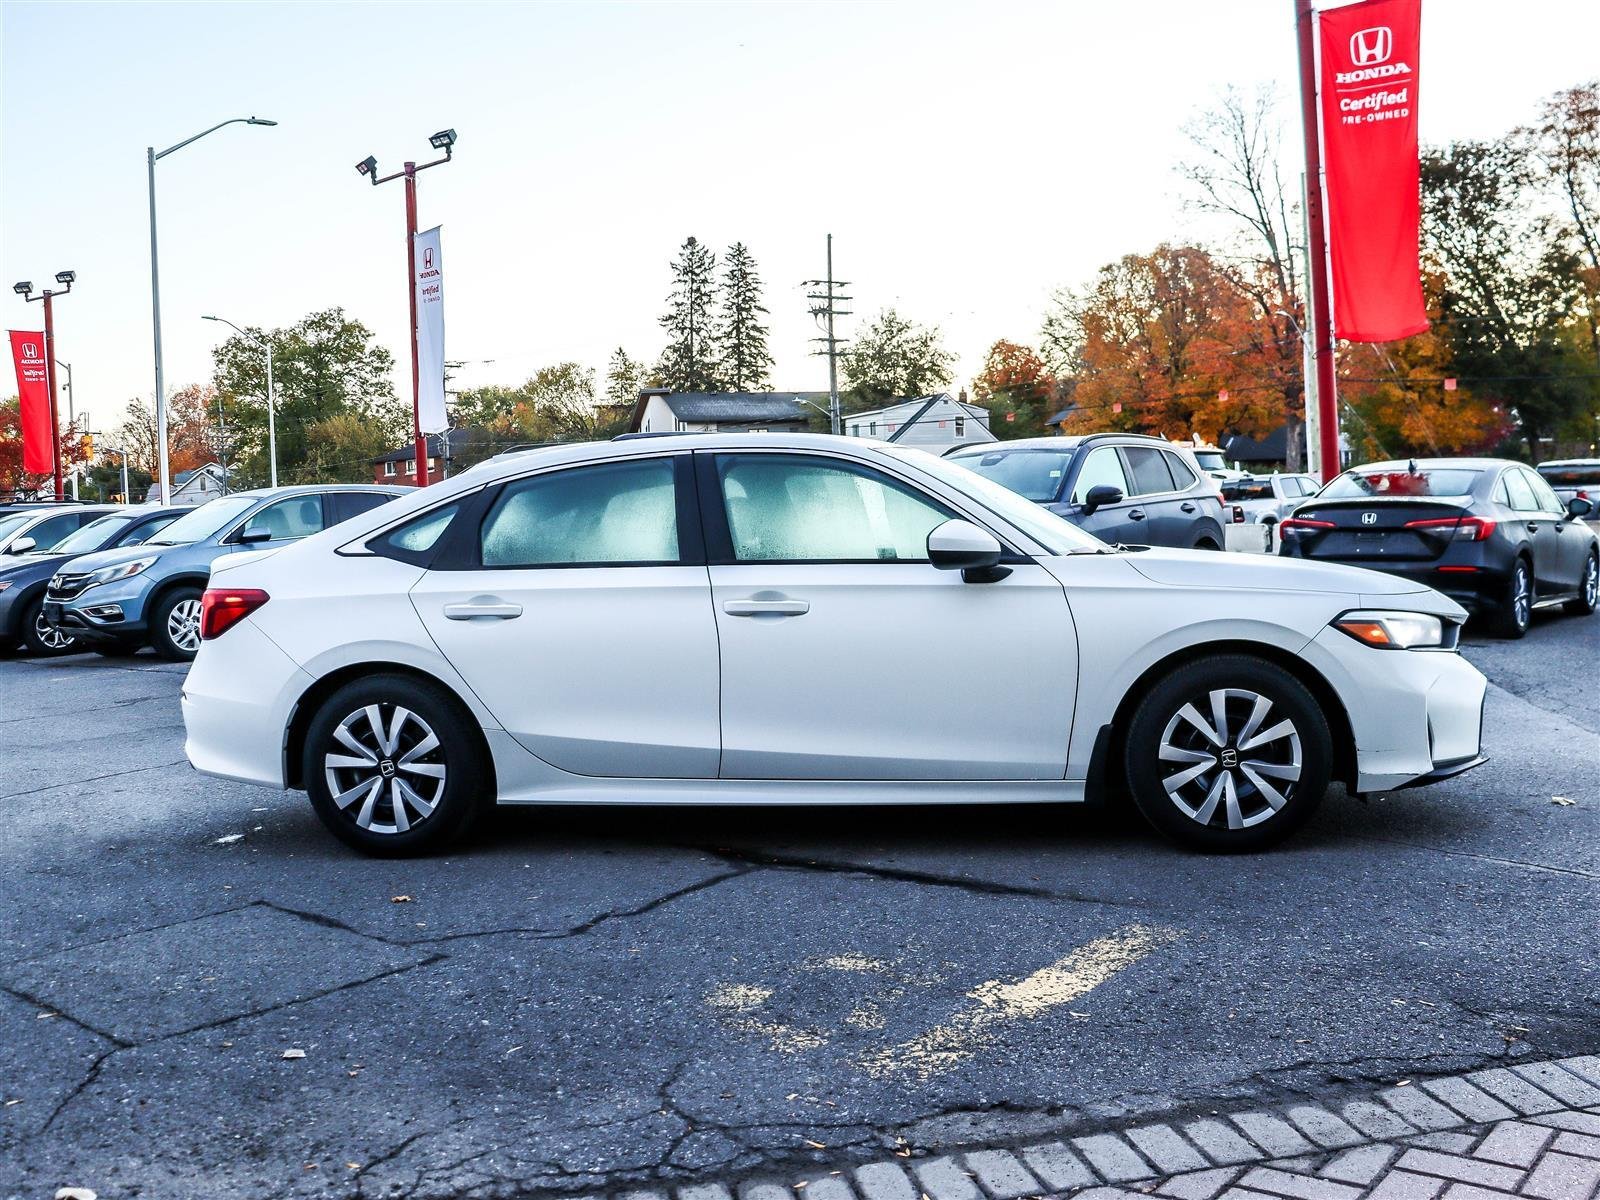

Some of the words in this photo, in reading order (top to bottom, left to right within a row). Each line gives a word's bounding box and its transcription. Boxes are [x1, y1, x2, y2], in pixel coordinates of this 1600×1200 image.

[1336, 62, 1412, 83] HONDA
[1340, 88, 1408, 111] Certified
[1342, 108, 1409, 124] PRE-OWNED
